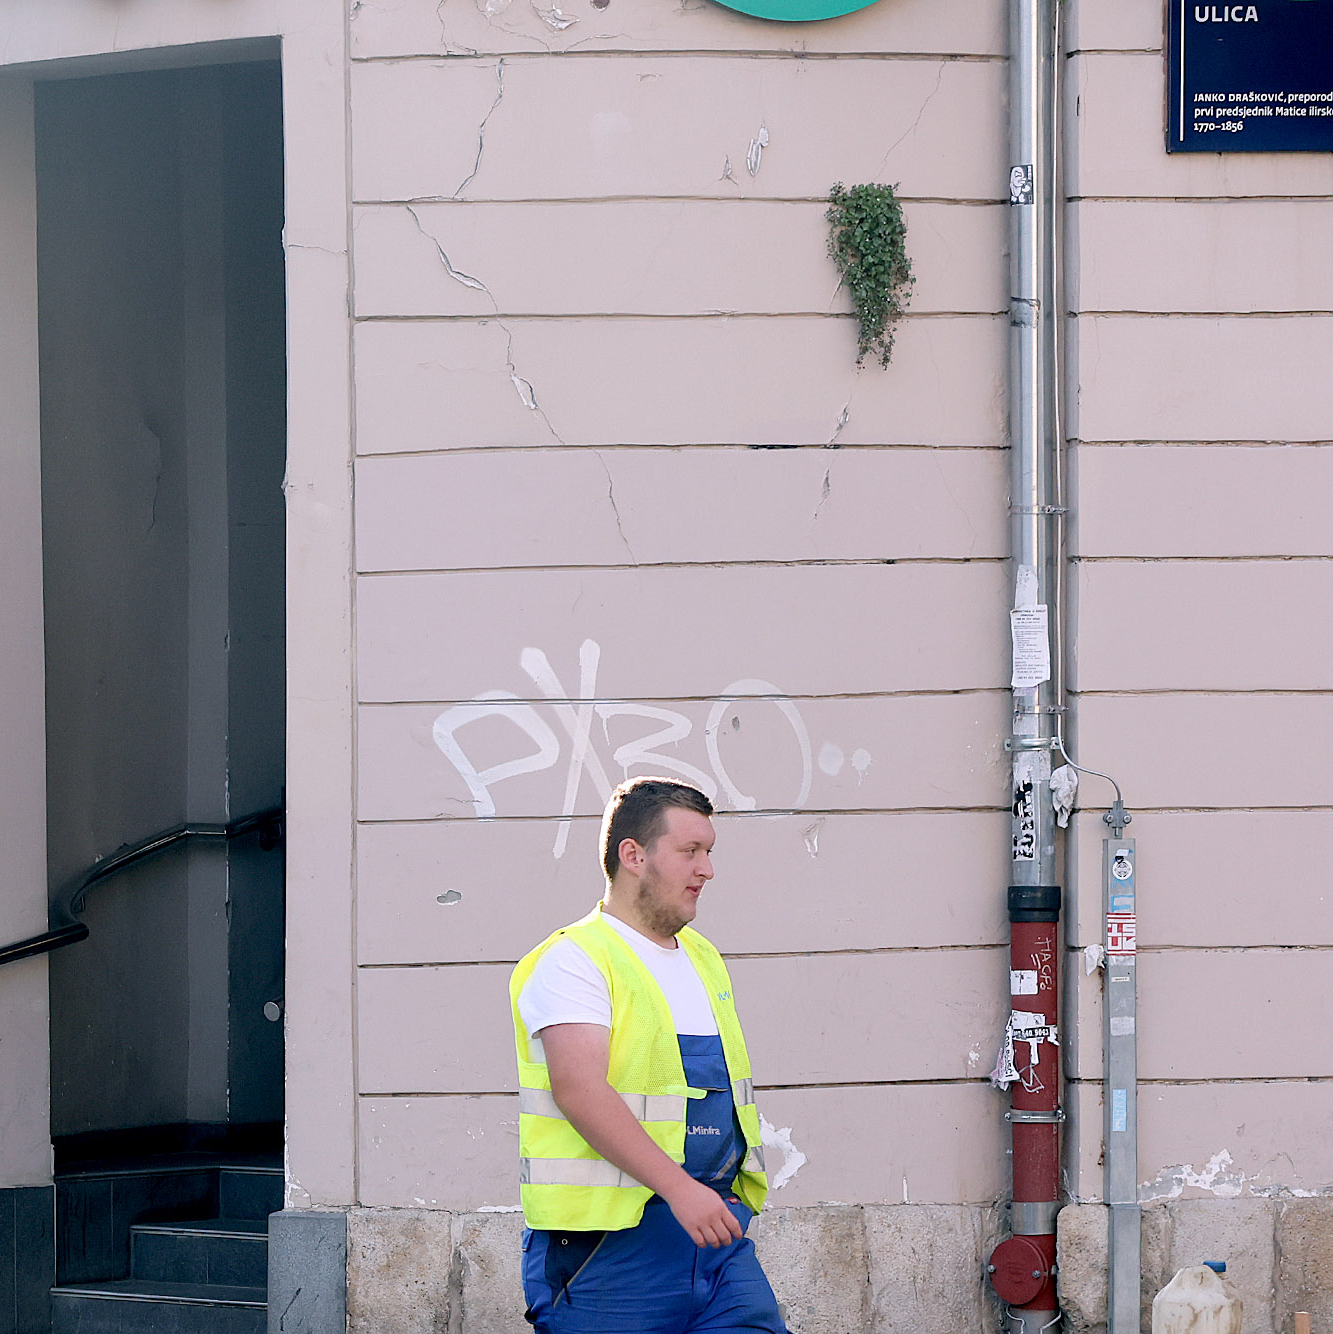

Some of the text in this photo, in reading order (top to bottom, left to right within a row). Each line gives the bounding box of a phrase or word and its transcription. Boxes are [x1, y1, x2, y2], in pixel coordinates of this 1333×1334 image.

[1194, 5, 1259, 23] ULICA
[1193, 93, 1226, 103] JANKO
[1194, 106, 1214, 118] prvi
[1216, 106, 1273, 118] predsjednik
[1275, 106, 1307, 117] Matice
